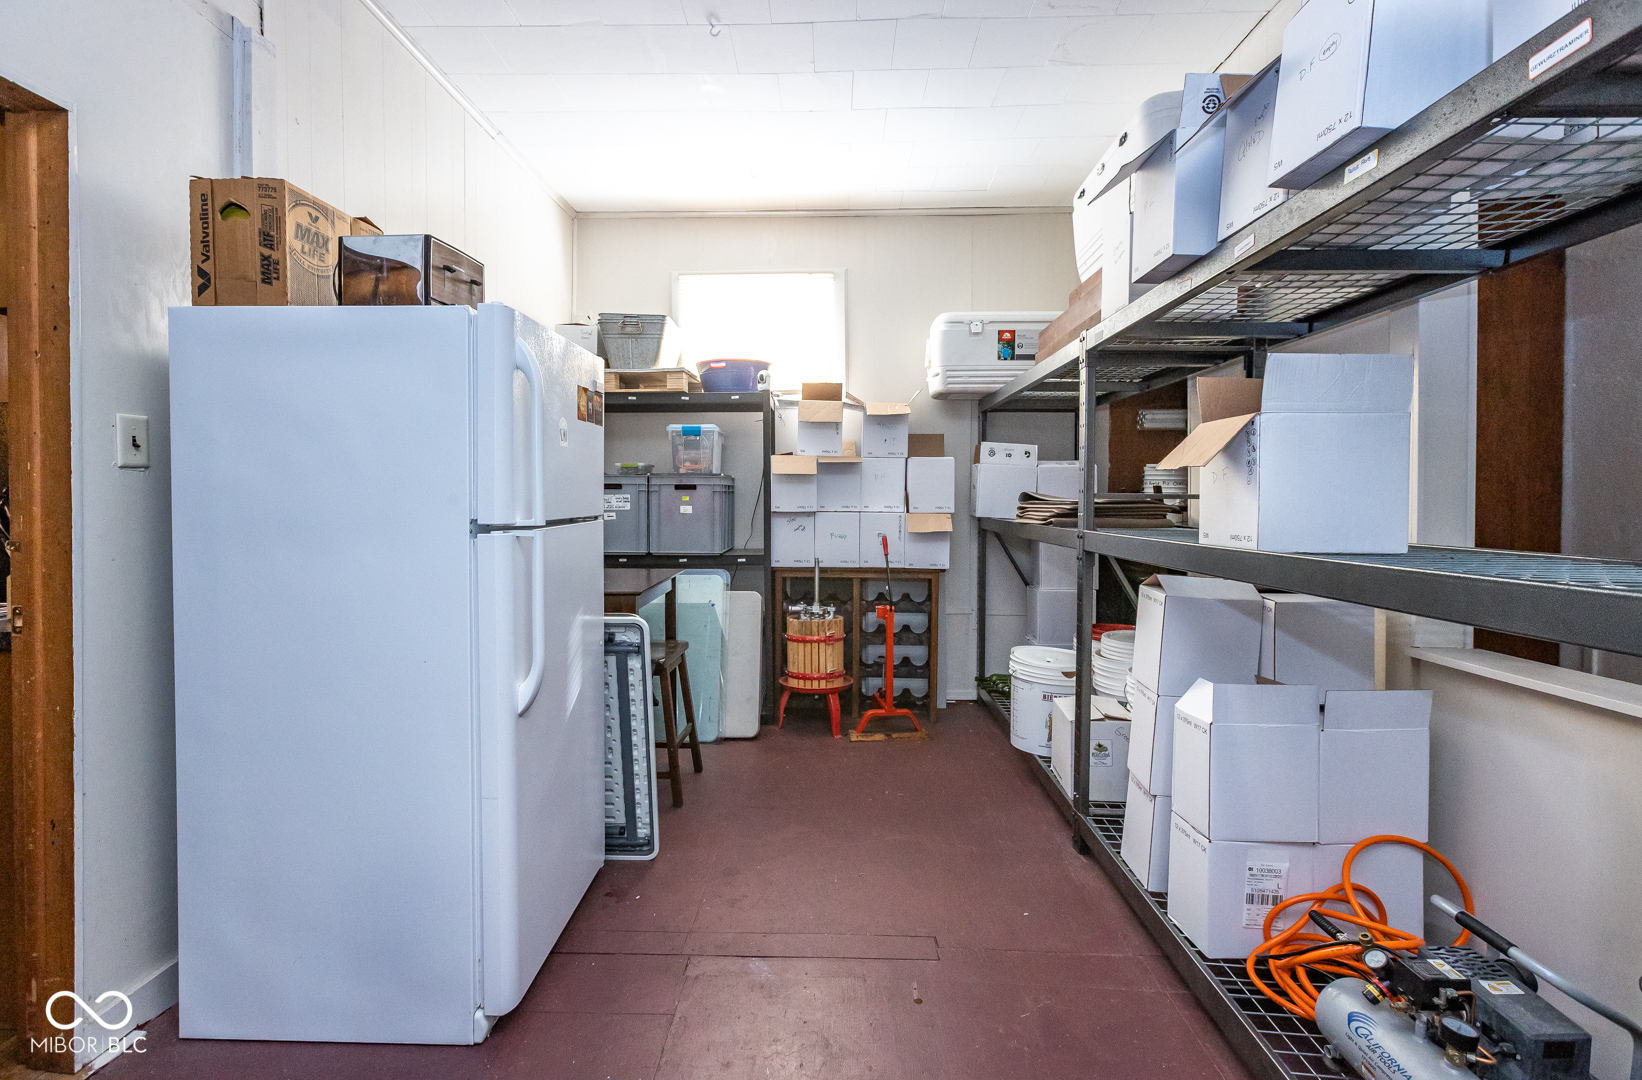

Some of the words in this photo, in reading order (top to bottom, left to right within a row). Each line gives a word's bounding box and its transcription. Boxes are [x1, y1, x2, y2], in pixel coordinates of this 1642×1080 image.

[1530, 28, 1590, 73] GEWURZTRAMINER
[1343, 110, 1353, 123] 12
[1316, 121, 1337, 141] 750ml
[199, 192, 212, 264] Valvoline
[294, 220, 332, 255] MAX
[261, 229, 276, 252] ATF
[301, 242, 326, 264] LIFE
[260, 251, 274, 287] MAX
[272, 258, 281, 282] LIFE
[1202, 727, 1208, 735] CK
[1192, 836, 1200, 847] W17
[1200, 844, 1207, 853] CK
[1344, 1032, 1355, 1043] Light
[1358, 1045, 1368, 1057] Quiet
[1354, 1026, 1413, 1080] CALIFORNIA
[1365, 1044, 1378, 1055] AIR
[1376, 1055, 1398, 1075] TOOLS
